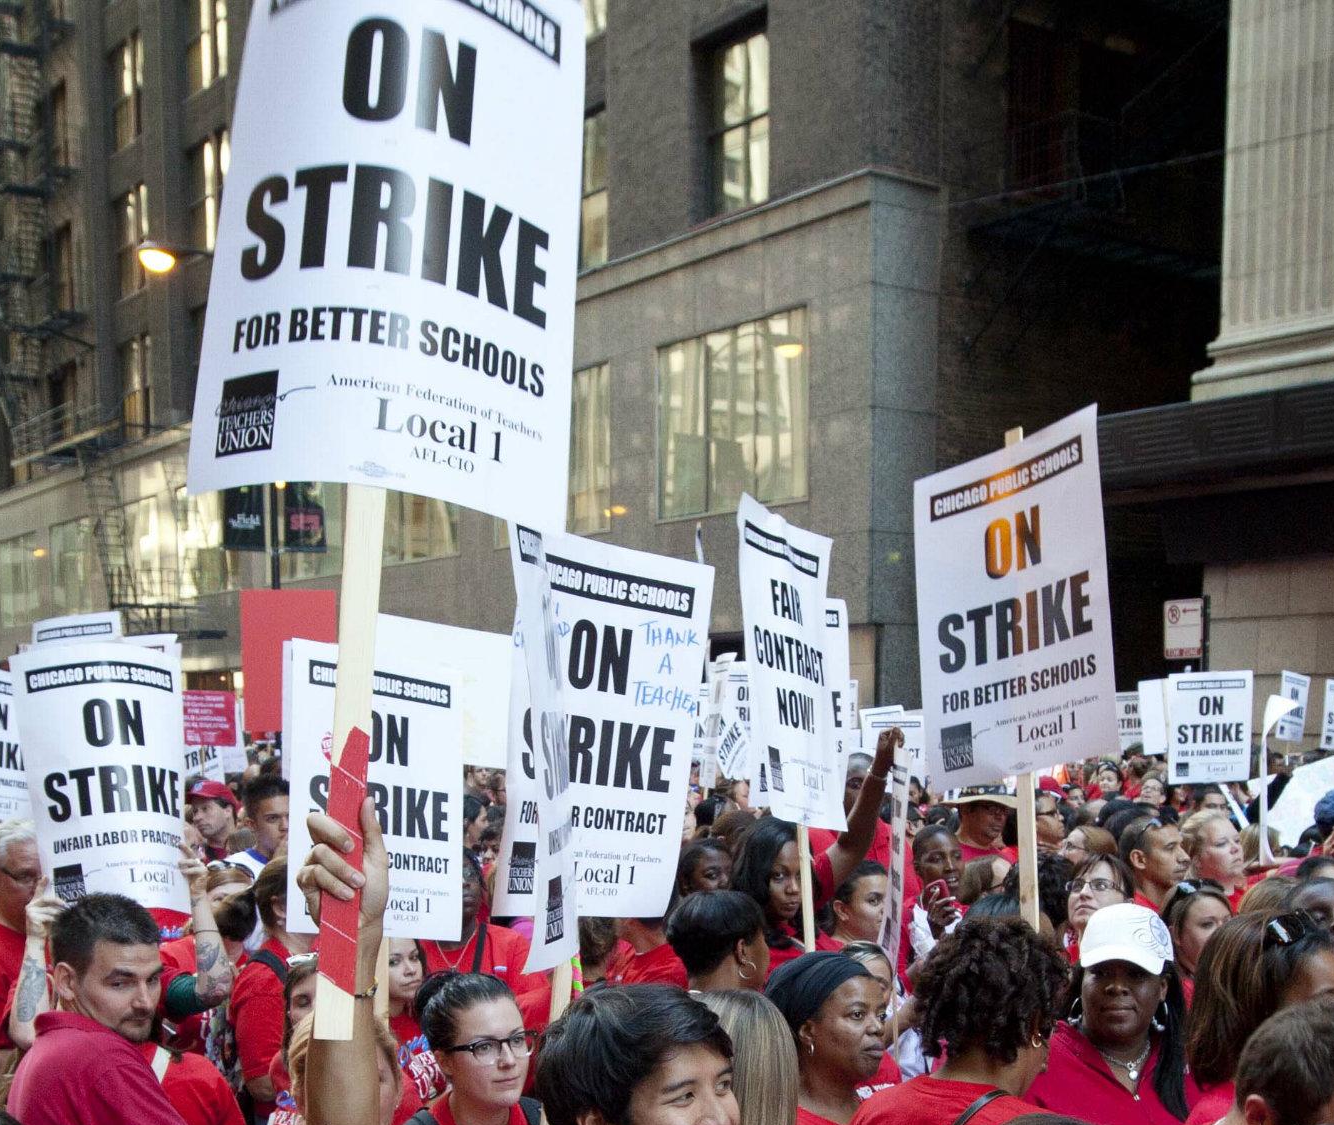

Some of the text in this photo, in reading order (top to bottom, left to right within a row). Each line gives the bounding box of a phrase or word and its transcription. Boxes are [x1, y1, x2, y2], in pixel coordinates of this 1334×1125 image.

[342, 16, 478, 147] ON
[240, 163, 549, 330] STRIKE
[232, 306, 546, 399] FOR BETTER SCHOOLS
[218, 408, 274, 433] TEACHERS
[326, 373, 544, 442] American Federation of Teachers
[217, 424, 273, 453] UNION
[375, 396, 503, 464] Local 1
[409, 444, 475, 475] AFL-CIO
[934, 442, 1079, 517] CHICAGO PUBLIC SCHOOLS
[985, 504, 1041, 579] ON
[583, 572, 691, 613] PUBLIC SCHOOLS
[770, 578, 804, 627] FAIR
[639, 619, 699, 648] THANK
[937, 570, 1092, 673] STRIKE
[567, 618, 633, 696] ON
[657, 652, 673, 676] A
[754, 625, 825, 687] CONTRACT
[29, 664, 172, 692] CHICAGO PUBLIC SCHOOLS
[373, 674, 449, 704] UBLIC SCHOOLS
[942, 654, 1097, 714] FOR BETTER SCHOOLS
[633, 680, 699, 717] TEACHER
[776, 686, 816, 735] NOW!
[1124, 703, 1139, 715] ON
[1199, 695, 1224, 716] ON
[82, 697, 146, 748] ON
[1017, 711, 1077, 744] Local 1
[1177, 722, 1244, 744] STRIKE
[719, 721, 743, 766] STRIKE
[1177, 748, 1244, 757] FOR A FAIR CONTRACT
[43, 764, 181, 823] STRIKE
[583, 806, 667, 836] CONTRACT
[53, 830, 138, 855] UNFAIR LABOR
[585, 850, 662, 864] Federation of Teachers
[129, 867, 169, 884] Local
[387, 851, 450, 875] CONTRACT
[574, 861, 636, 886] Local 1
[508, 877, 534, 892] UNION
[584, 887, 618, 897] AFL-CIO
[424, 897, 431, 914] 1
